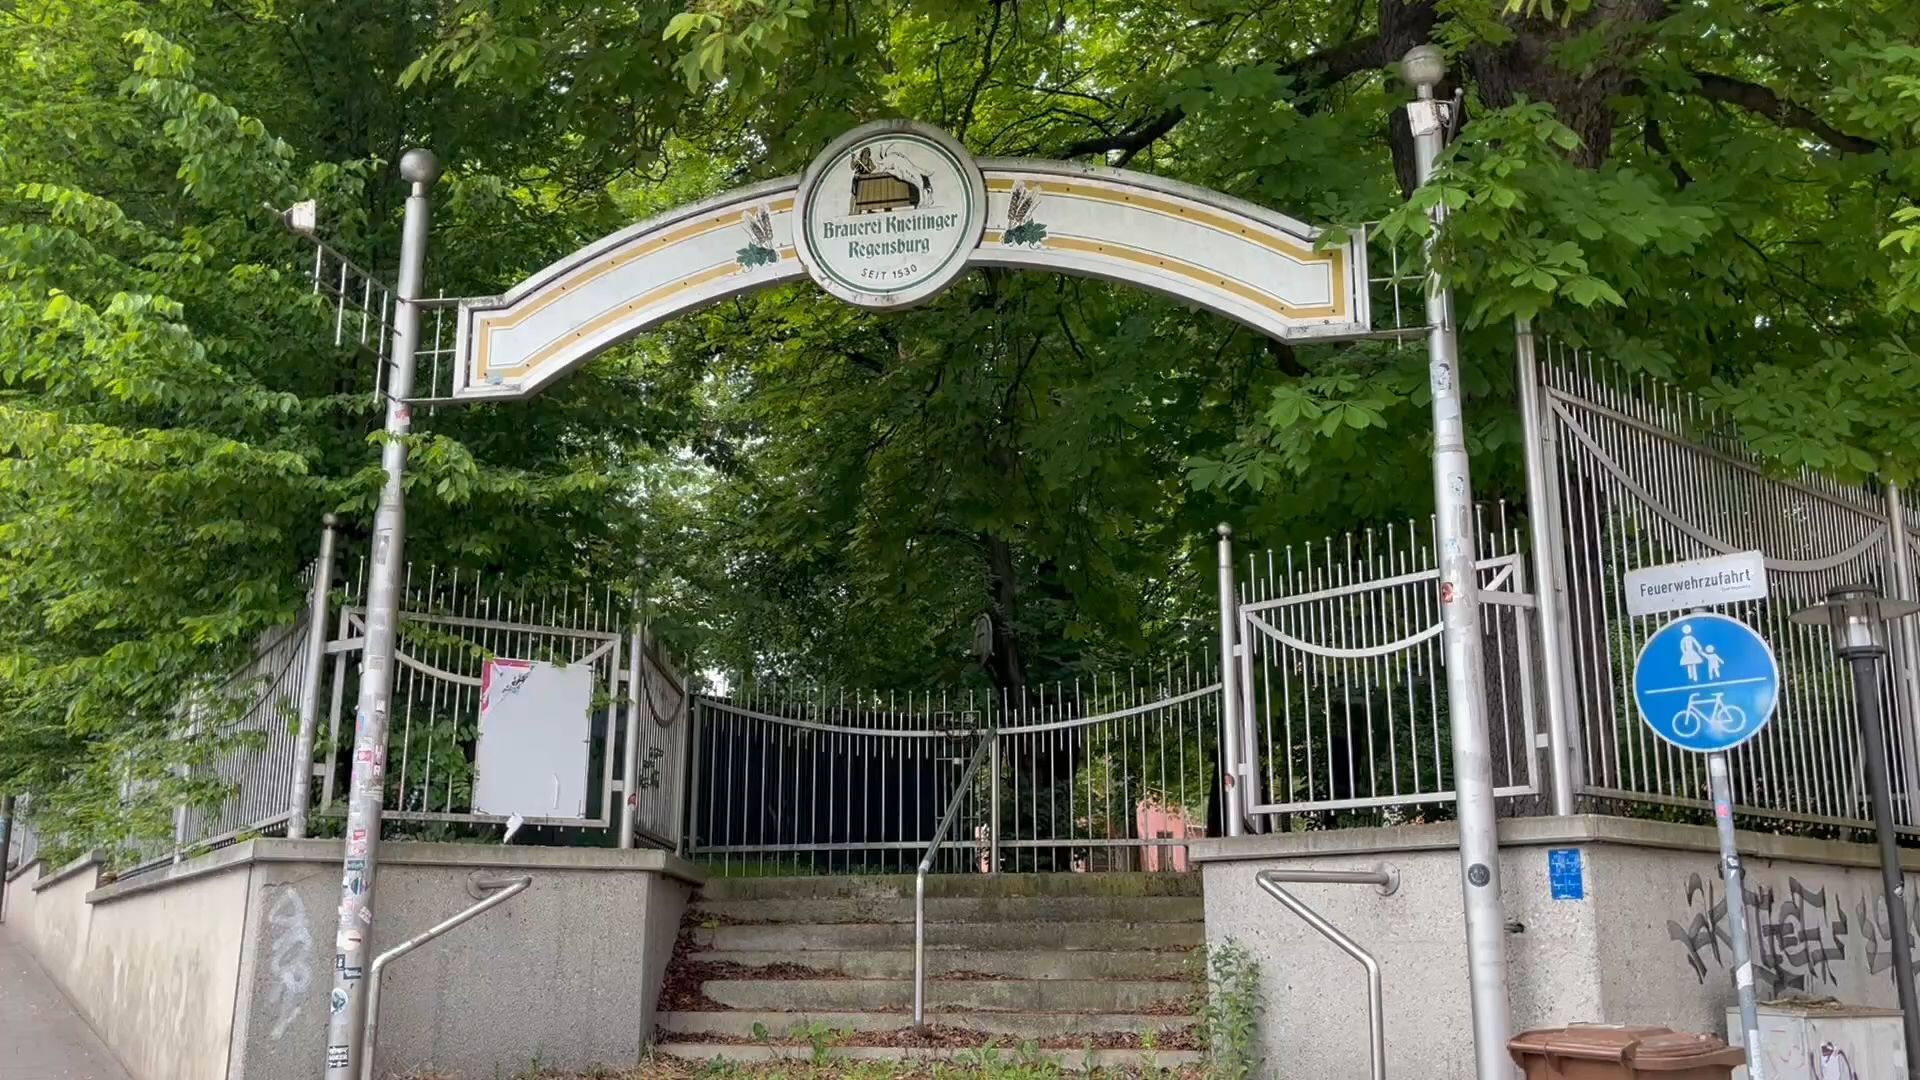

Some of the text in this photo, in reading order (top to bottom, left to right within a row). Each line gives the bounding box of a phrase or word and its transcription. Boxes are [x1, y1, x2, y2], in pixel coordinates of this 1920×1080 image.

[823, 212, 958, 239] Brauerei Kneitinger
[848, 238, 930, 258] Regensburg
[861, 264, 918, 279] SEIT 1530
[1640, 568, 1751, 597] Feuerwehrzufahrt
